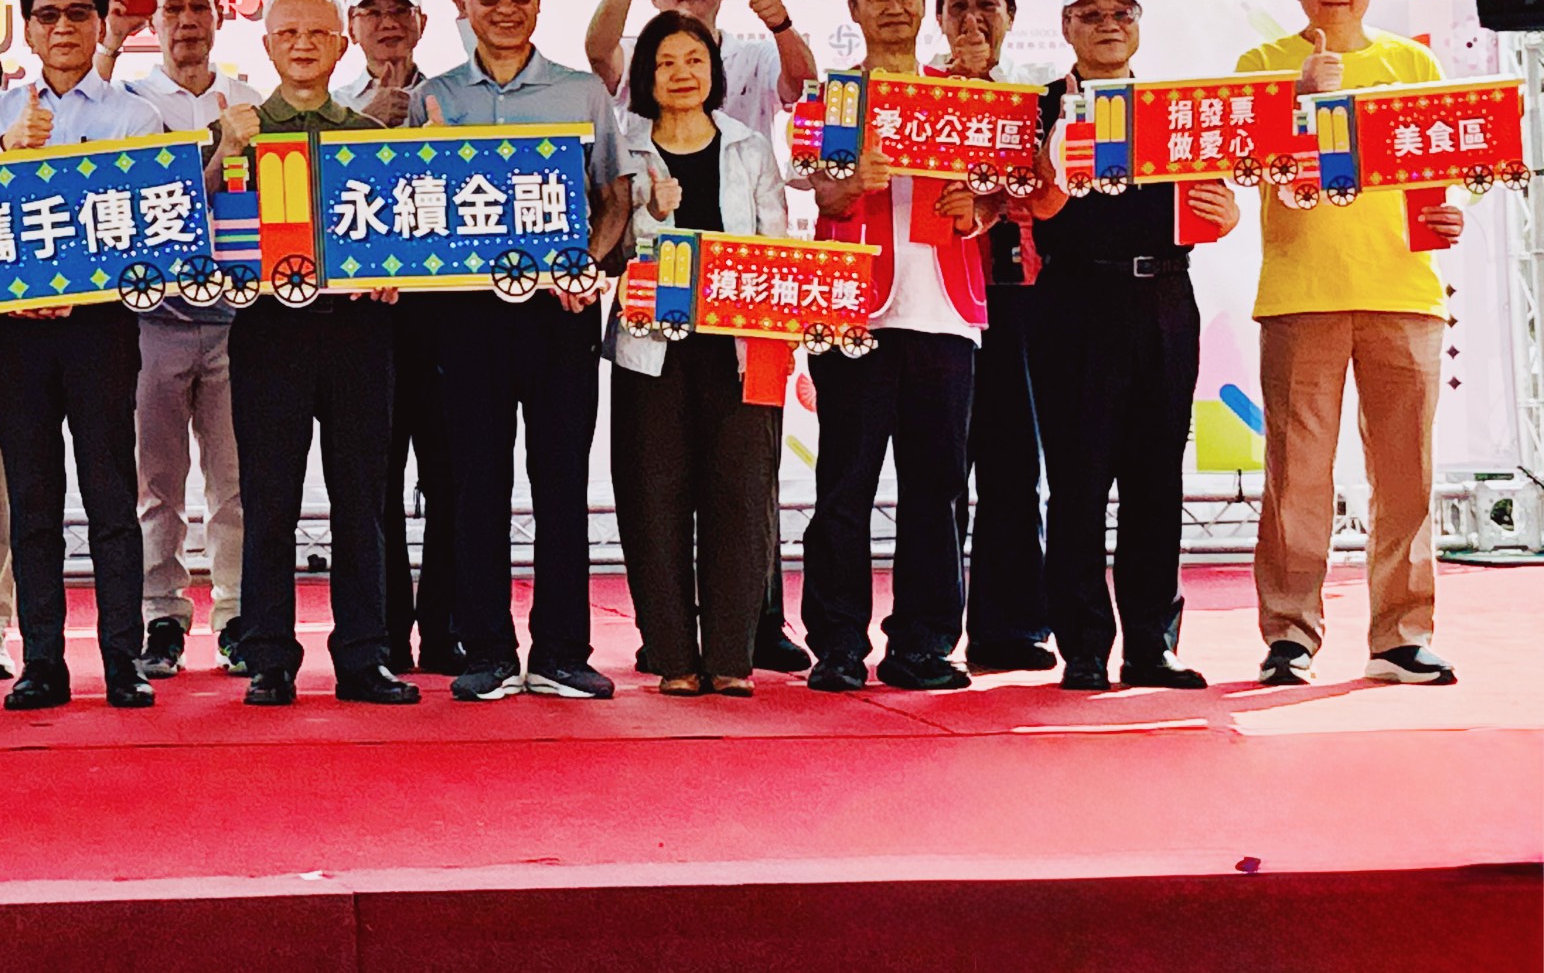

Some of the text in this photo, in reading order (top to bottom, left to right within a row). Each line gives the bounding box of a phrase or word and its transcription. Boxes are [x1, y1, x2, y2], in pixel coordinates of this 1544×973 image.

[872, 108, 1022, 149] 愛心公益區
[1169, 97, 1254, 129] 捐發票
[1168, 131, 1253, 161] 做愛心
[1395, 119, 1487, 156] 美食區
[332, 173, 569, 240] 永續金融
[708, 269, 864, 310] 摸彩抽大獎
